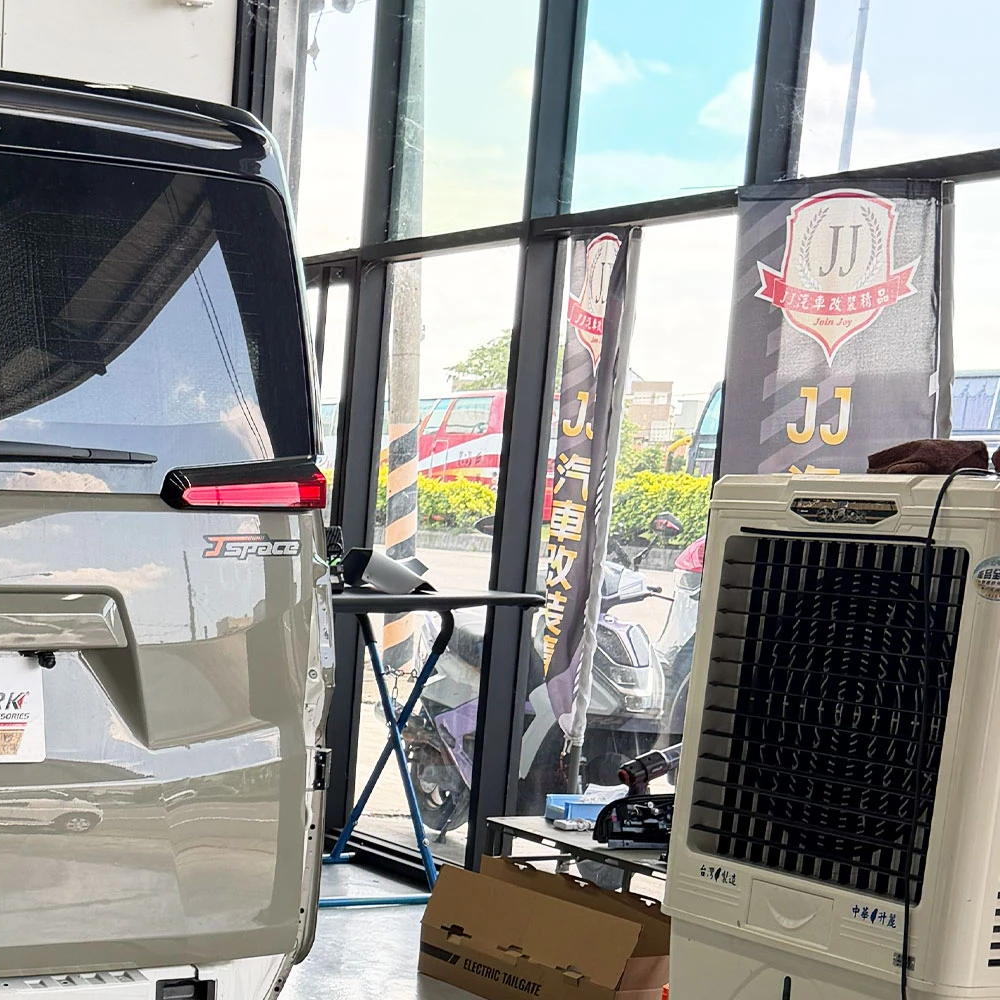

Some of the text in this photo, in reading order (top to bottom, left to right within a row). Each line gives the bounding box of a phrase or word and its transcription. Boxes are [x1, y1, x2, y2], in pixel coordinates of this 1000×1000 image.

[818, 225, 863, 277] JJ
[779, 288, 889, 312] JJ汽車改裝精品
[813, 317, 852, 328] Join Joy
[786, 387, 852, 446] JJ
[463, 958, 542, 997] ELECTRIC TAILGATE
